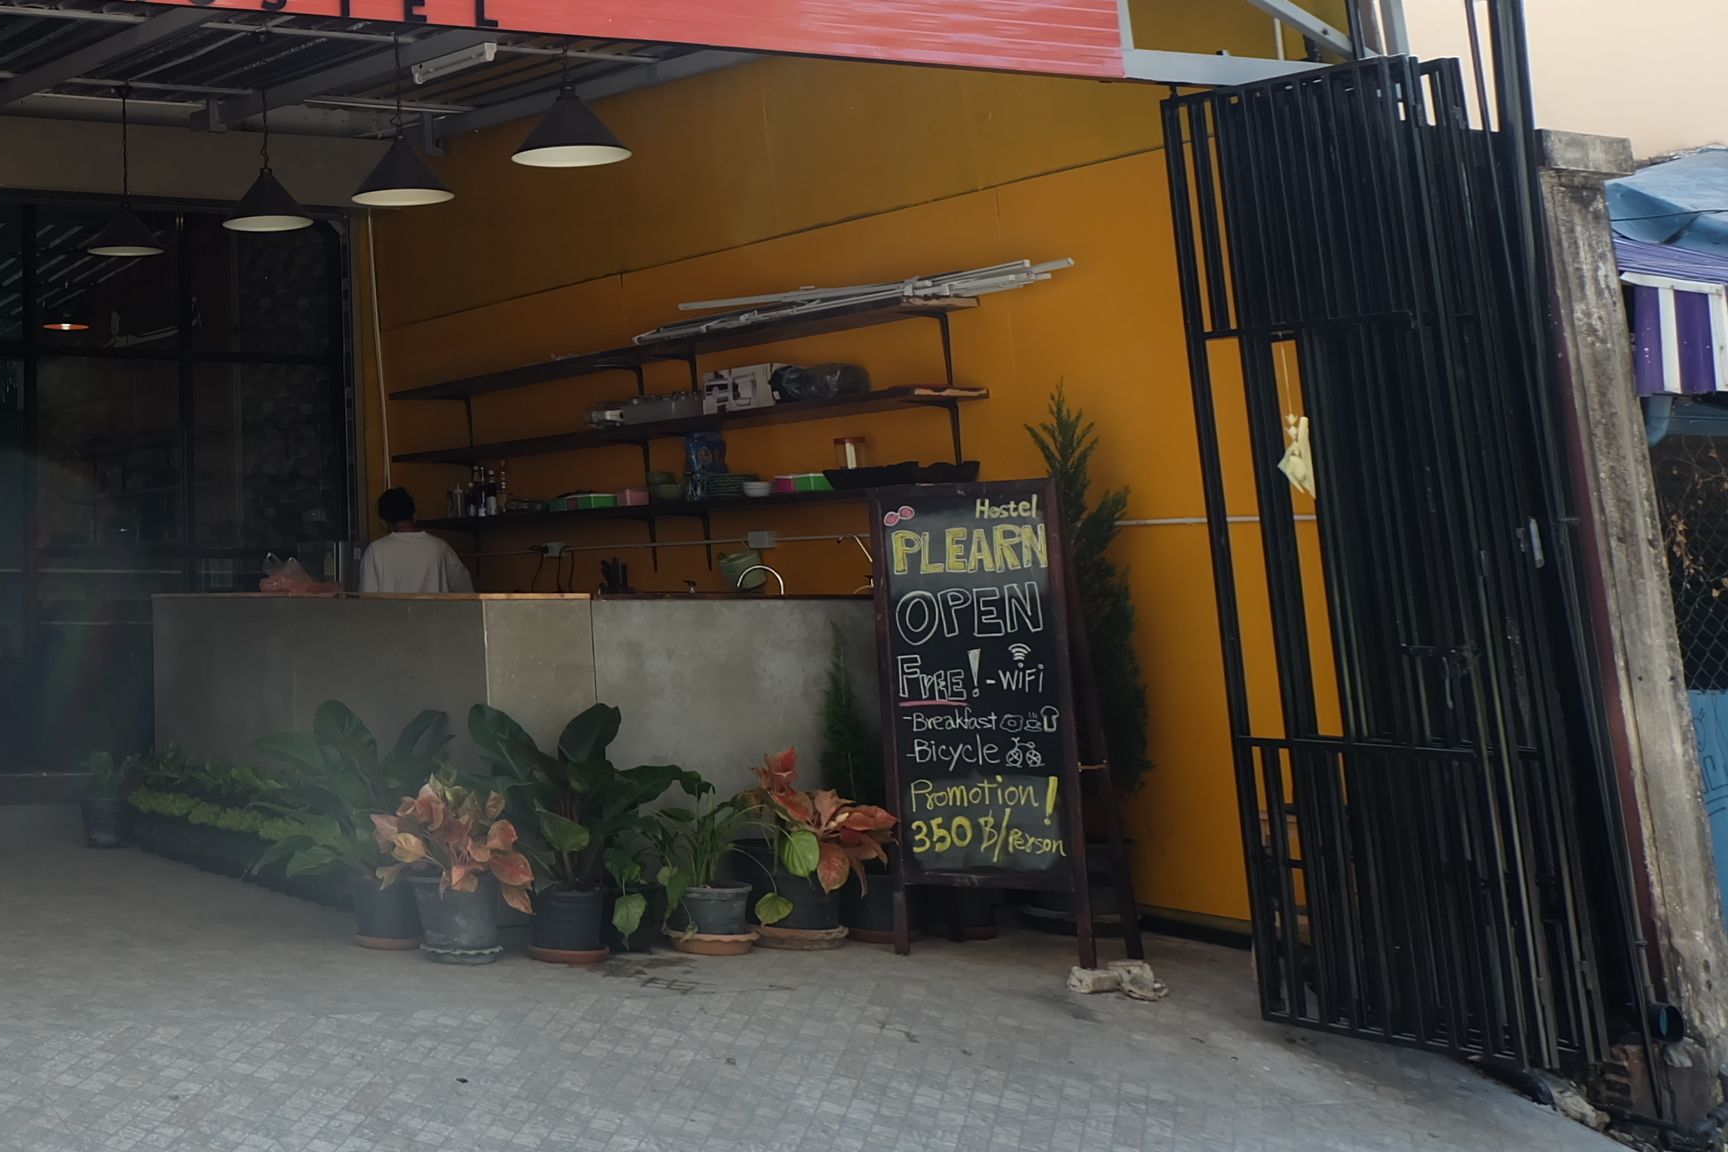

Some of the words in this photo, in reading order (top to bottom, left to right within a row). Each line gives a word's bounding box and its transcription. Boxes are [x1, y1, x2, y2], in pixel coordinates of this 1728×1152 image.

[975, 493, 1038, 519] Hostel
[891, 523, 1048, 575] PLEARN
[895, 581, 1044, 646] OPEN
[911, 815, 972, 854] 350
